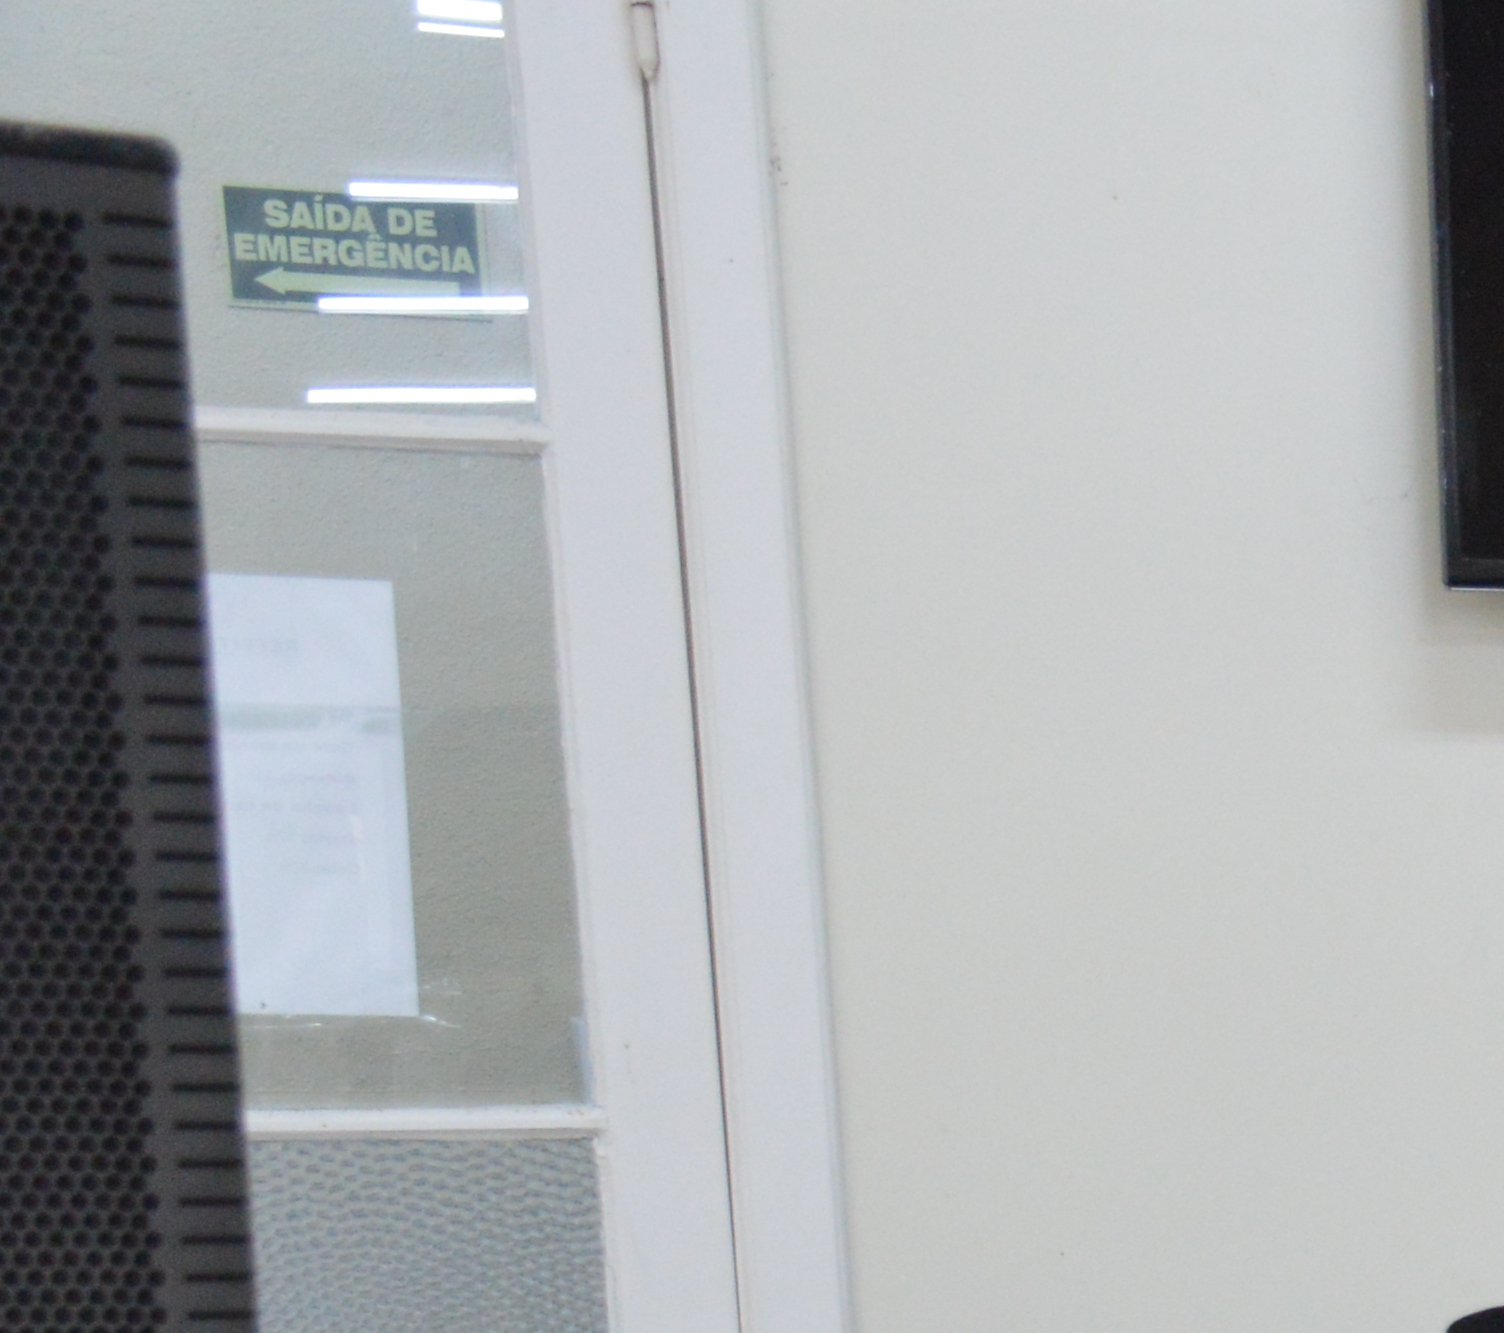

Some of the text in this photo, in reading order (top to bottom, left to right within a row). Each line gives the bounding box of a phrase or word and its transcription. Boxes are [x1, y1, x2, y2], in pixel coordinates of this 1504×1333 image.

[263, 194, 437, 238] SAÍDA DE
[233, 232, 476, 275] EMERGÊNCIA
